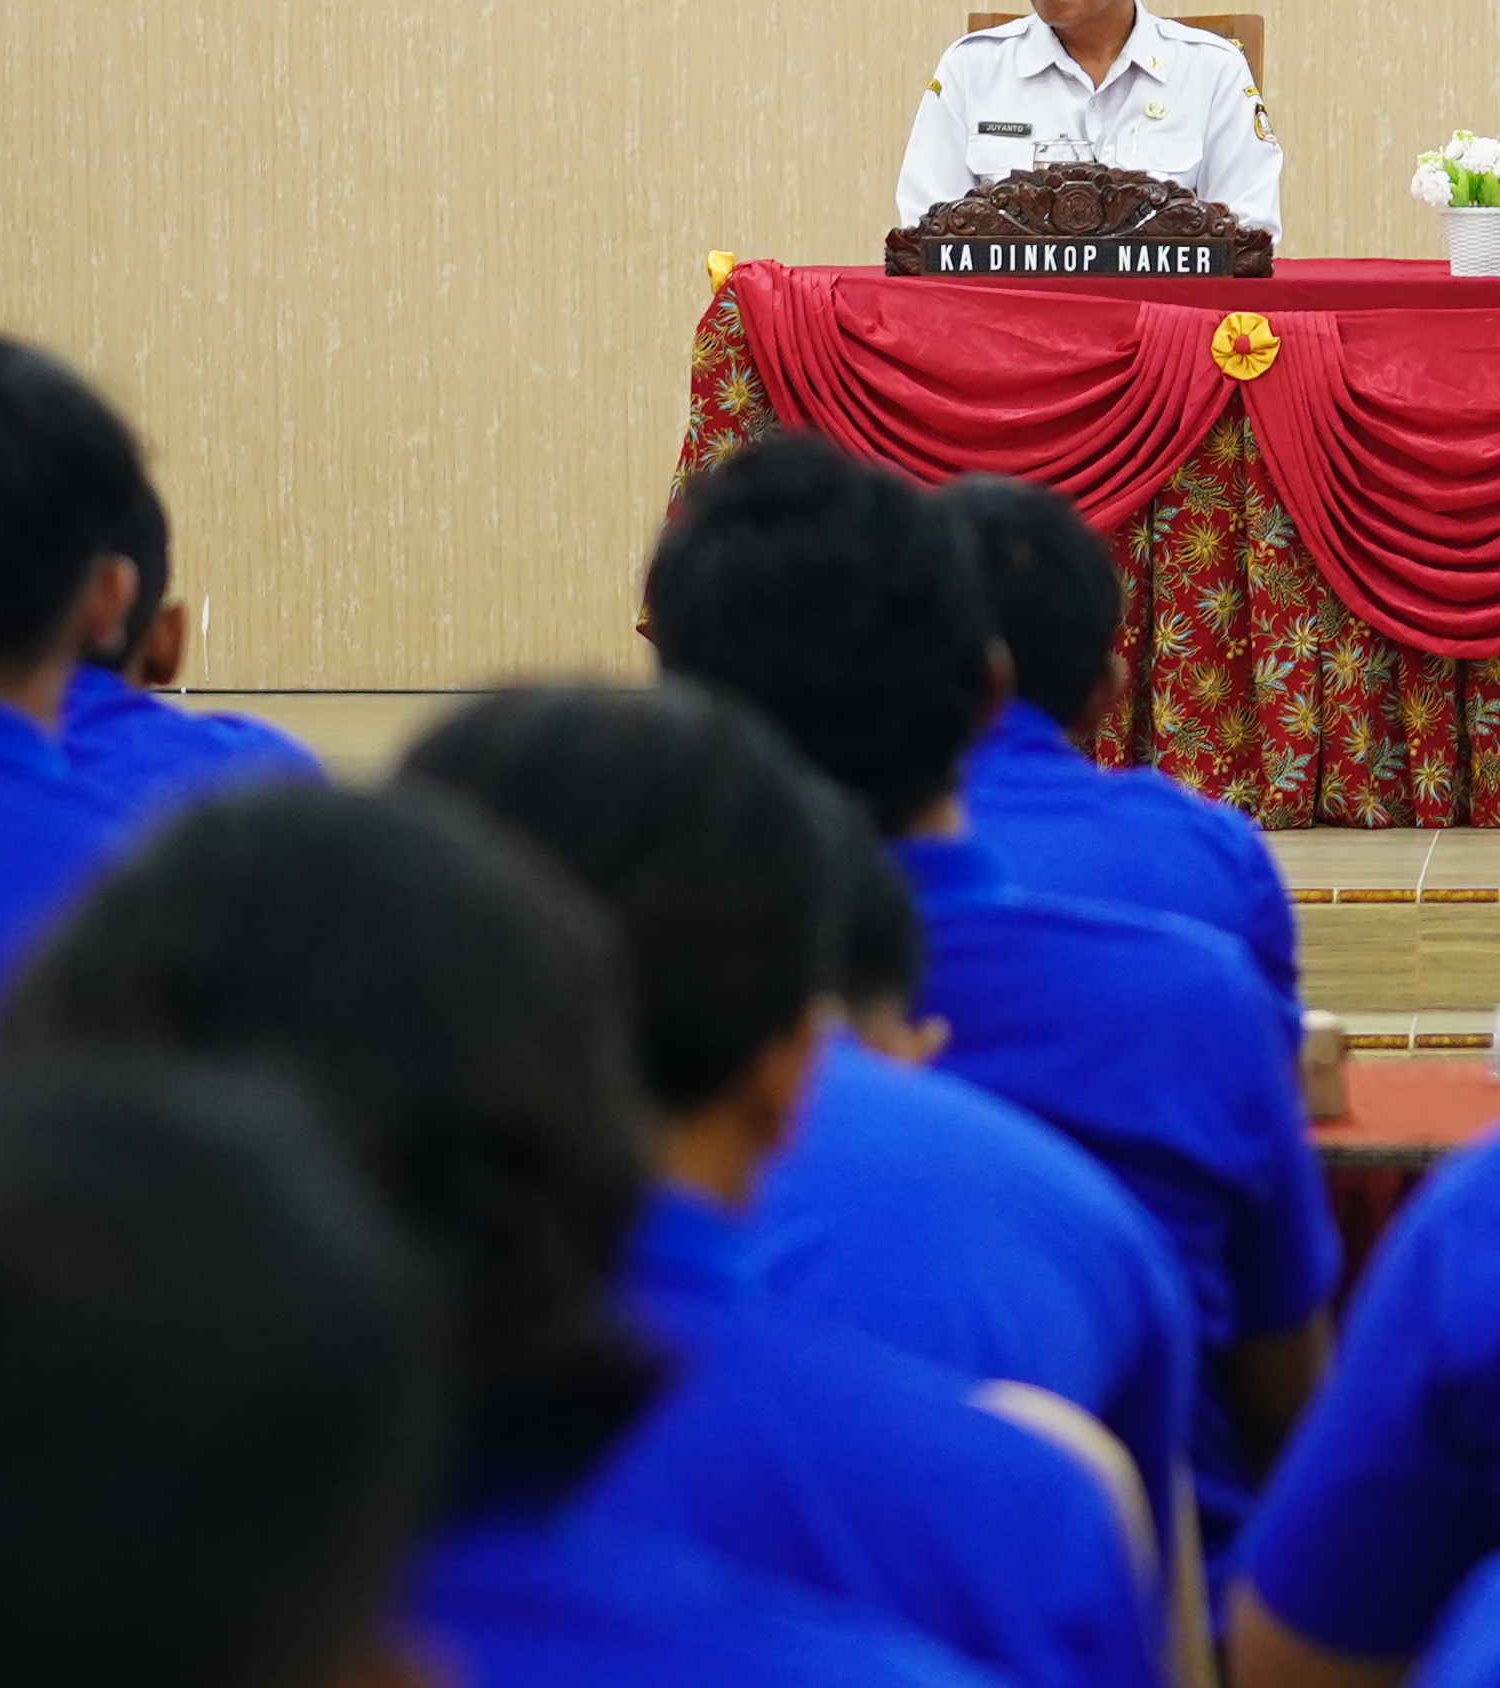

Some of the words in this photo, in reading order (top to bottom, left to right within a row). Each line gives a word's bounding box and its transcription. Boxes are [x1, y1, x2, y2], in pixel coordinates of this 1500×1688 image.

[940, 244, 974, 272] KA
[989, 244, 1098, 272] DINKOP
[1118, 245, 1211, 274] NAKER
